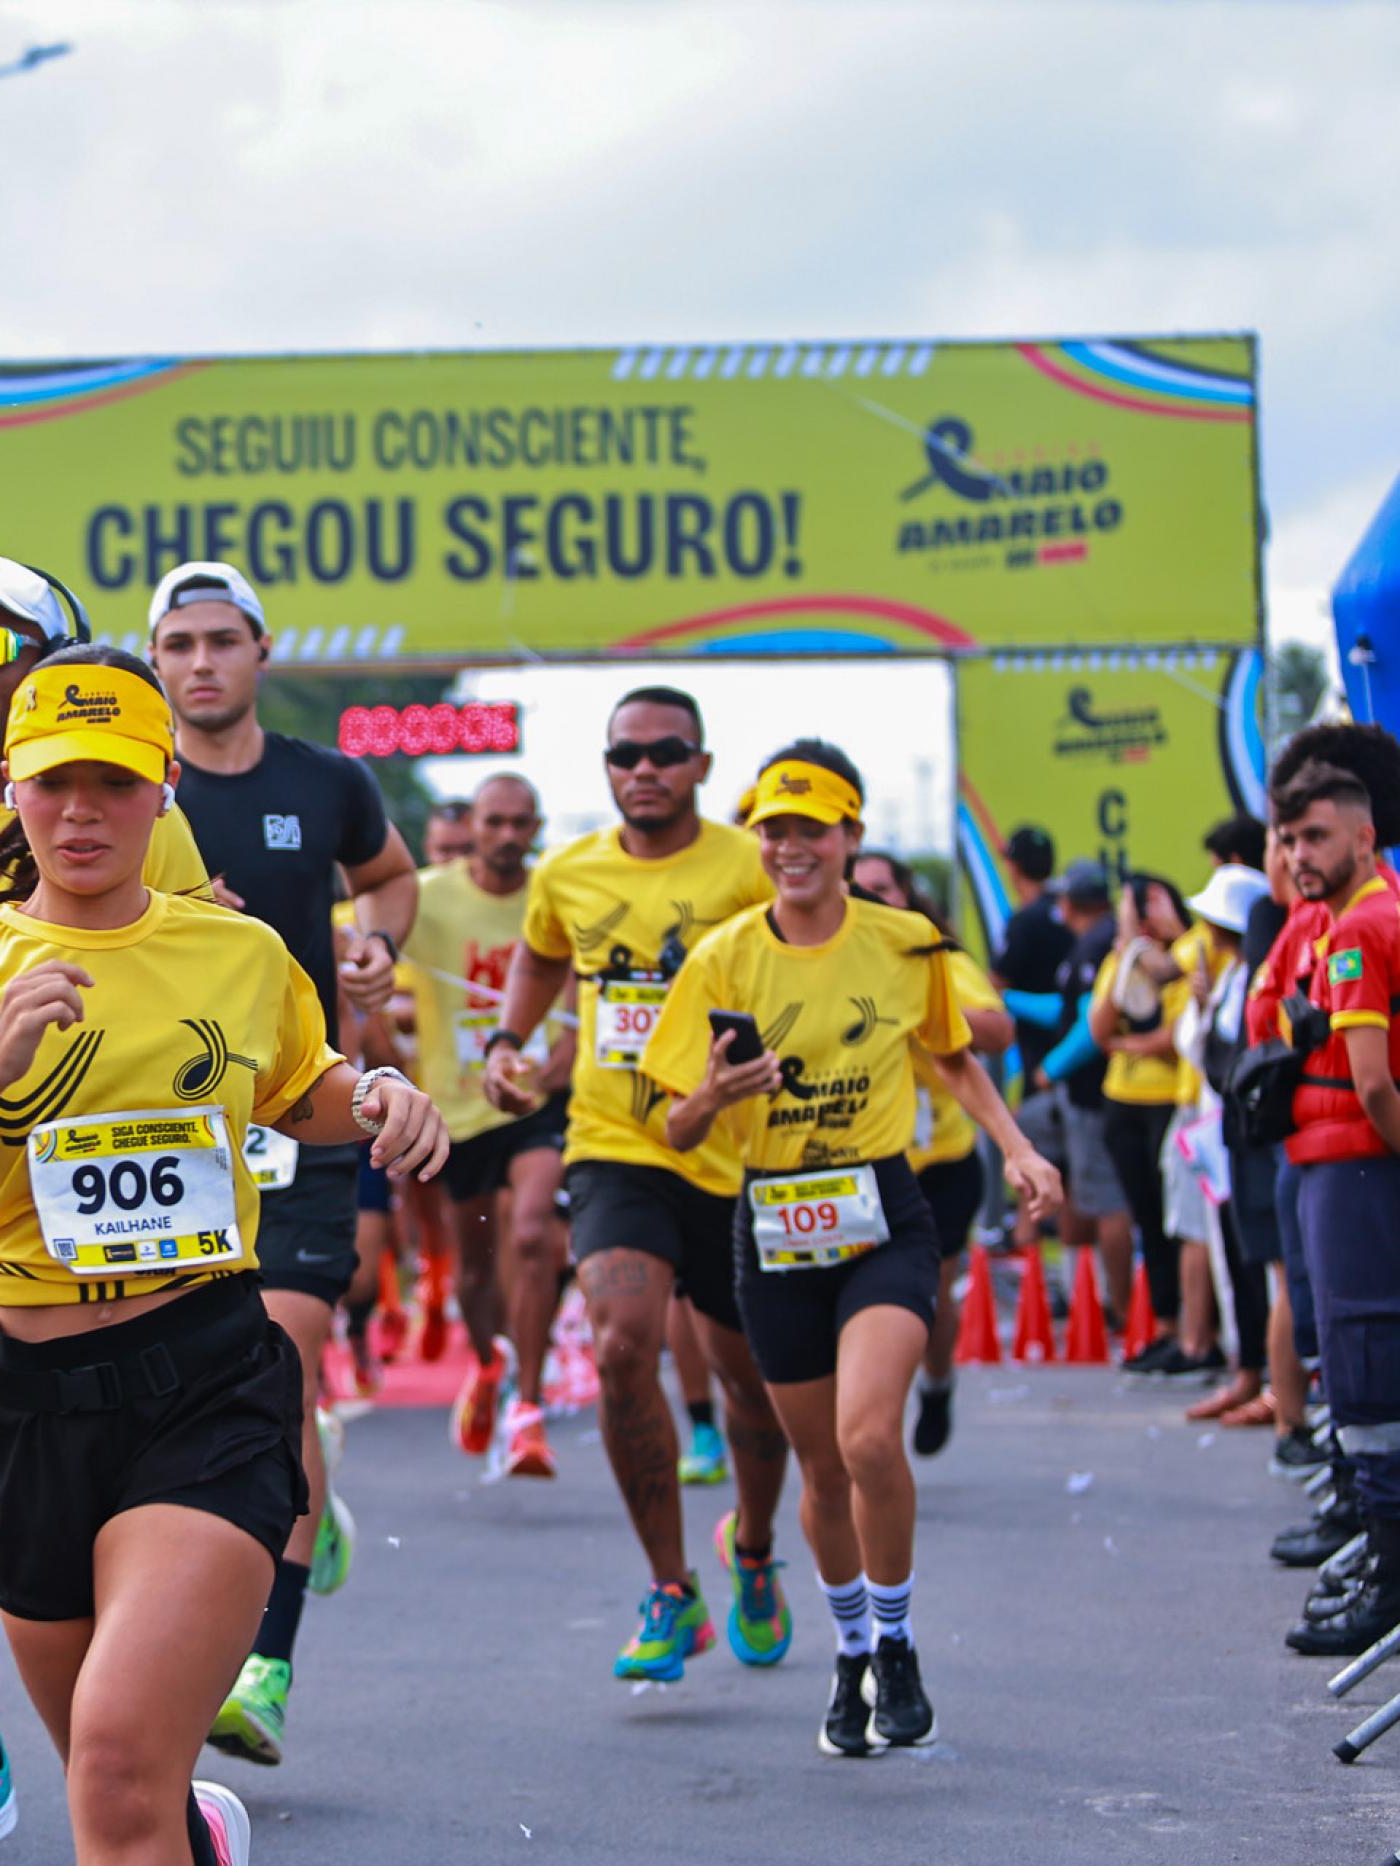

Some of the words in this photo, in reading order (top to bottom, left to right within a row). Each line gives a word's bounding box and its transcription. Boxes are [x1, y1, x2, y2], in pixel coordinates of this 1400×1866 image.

[175, 413, 356, 475] SEGUIU
[373, 404, 706, 473] CONSCIENTE,
[88, 496, 415, 590] CHEGOU
[444, 490, 803, 582] SEGURO!
[615, 1005, 662, 1034] 30
[72, 1156, 185, 1216] 906
[94, 1215, 172, 1236] KAILHANE
[777, 1202, 839, 1236] 109
[197, 1228, 233, 1256] 5K
